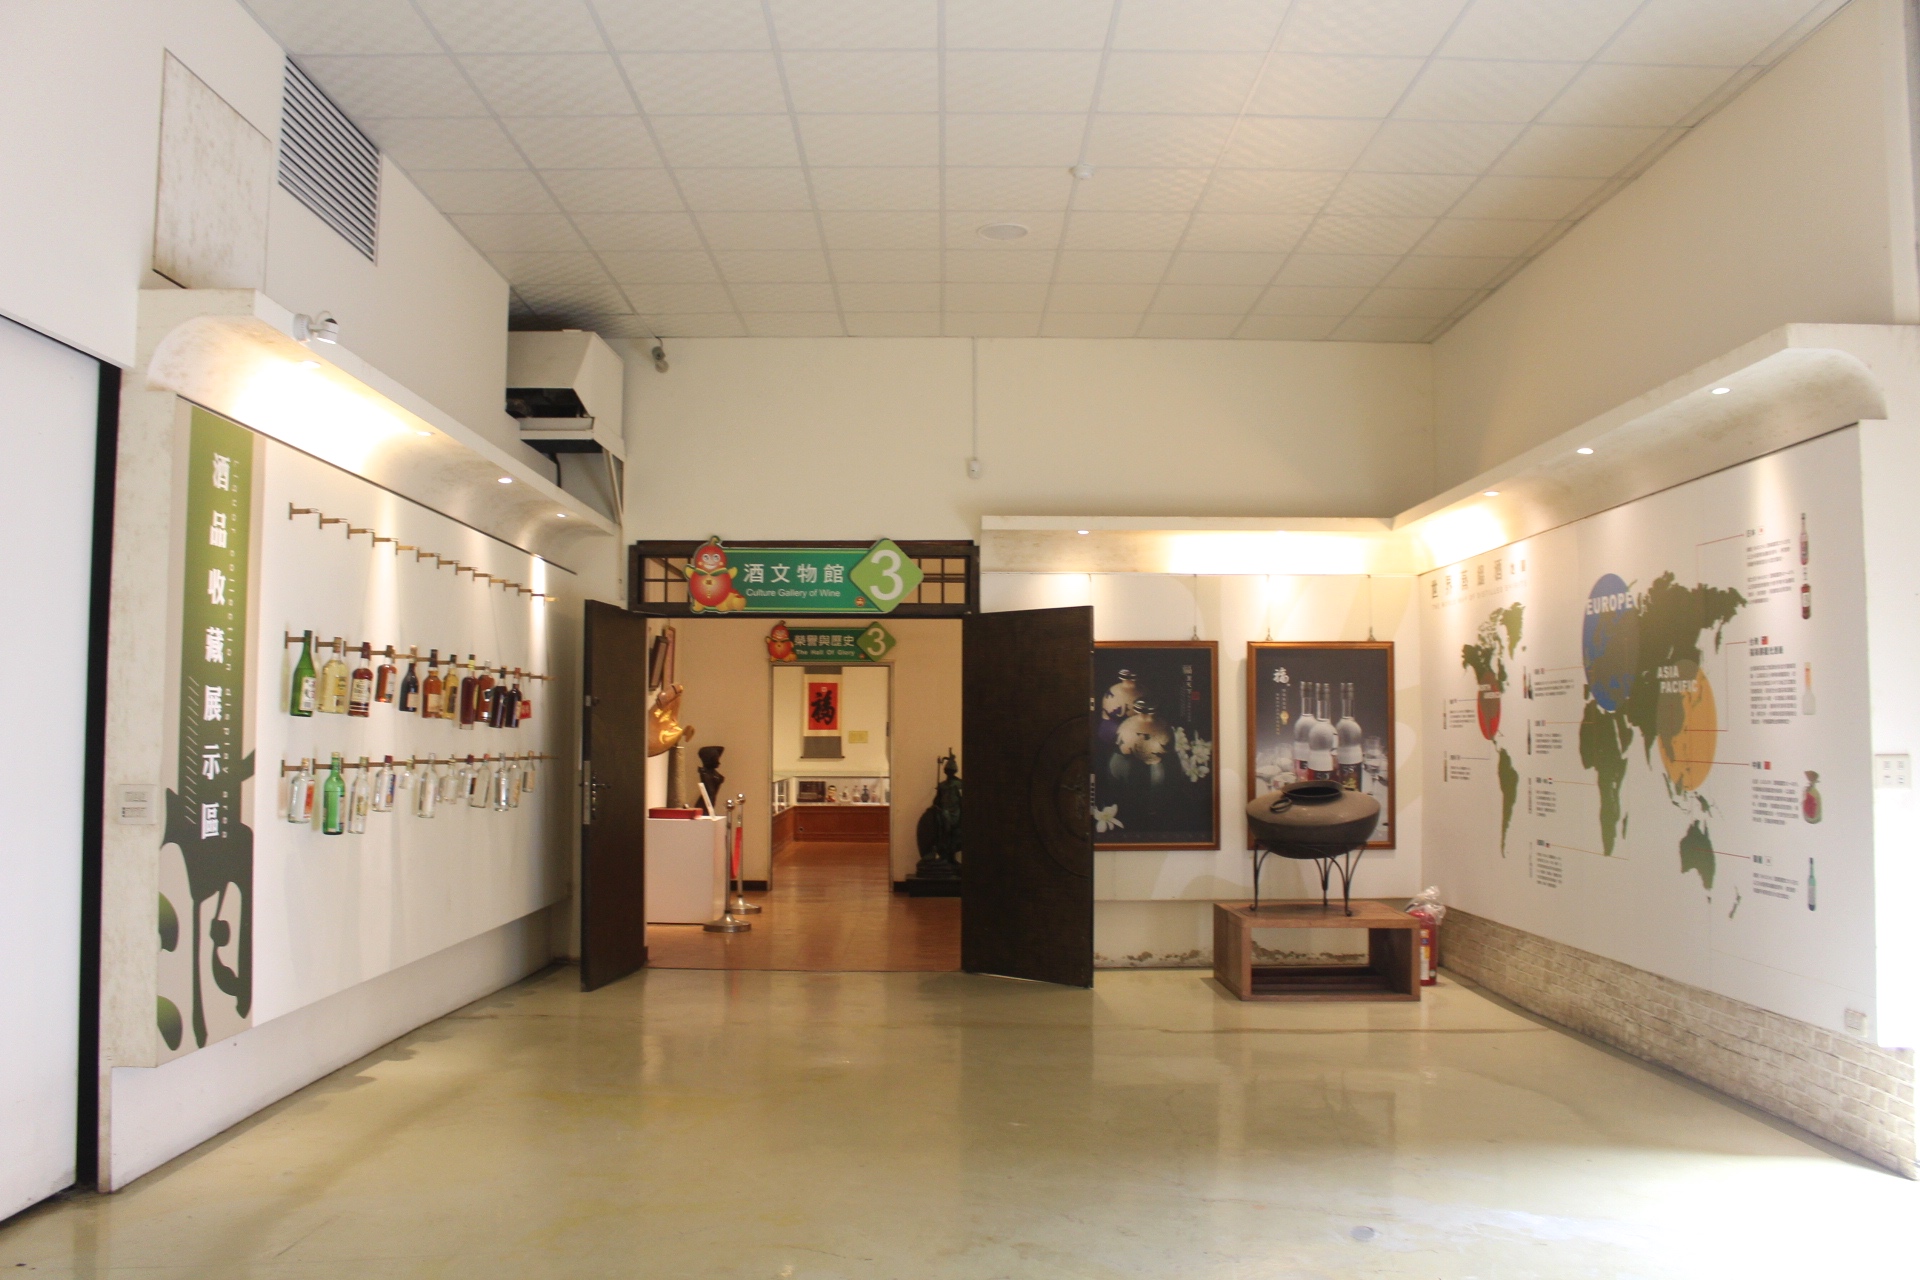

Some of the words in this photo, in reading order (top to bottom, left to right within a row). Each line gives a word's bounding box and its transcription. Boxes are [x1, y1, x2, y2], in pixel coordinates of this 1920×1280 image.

[743, 563, 845, 584] 酒文物館
[869, 549, 904, 601] 3
[745, 588, 776, 597] Culture
[777, 588, 807, 599] Gallery
[808, 588, 818, 597] of
[819, 588, 841, 597] Wine
[1586, 591, 1633, 615] EUROPE
[200, 452, 231, 840] 酒品收藏展示區
[867, 627, 887, 656] 3
[1272, 666, 1290, 684] 福
[1657, 665, 1679, 679] ASIA
[1660, 679, 1698, 694] PACIFIC
